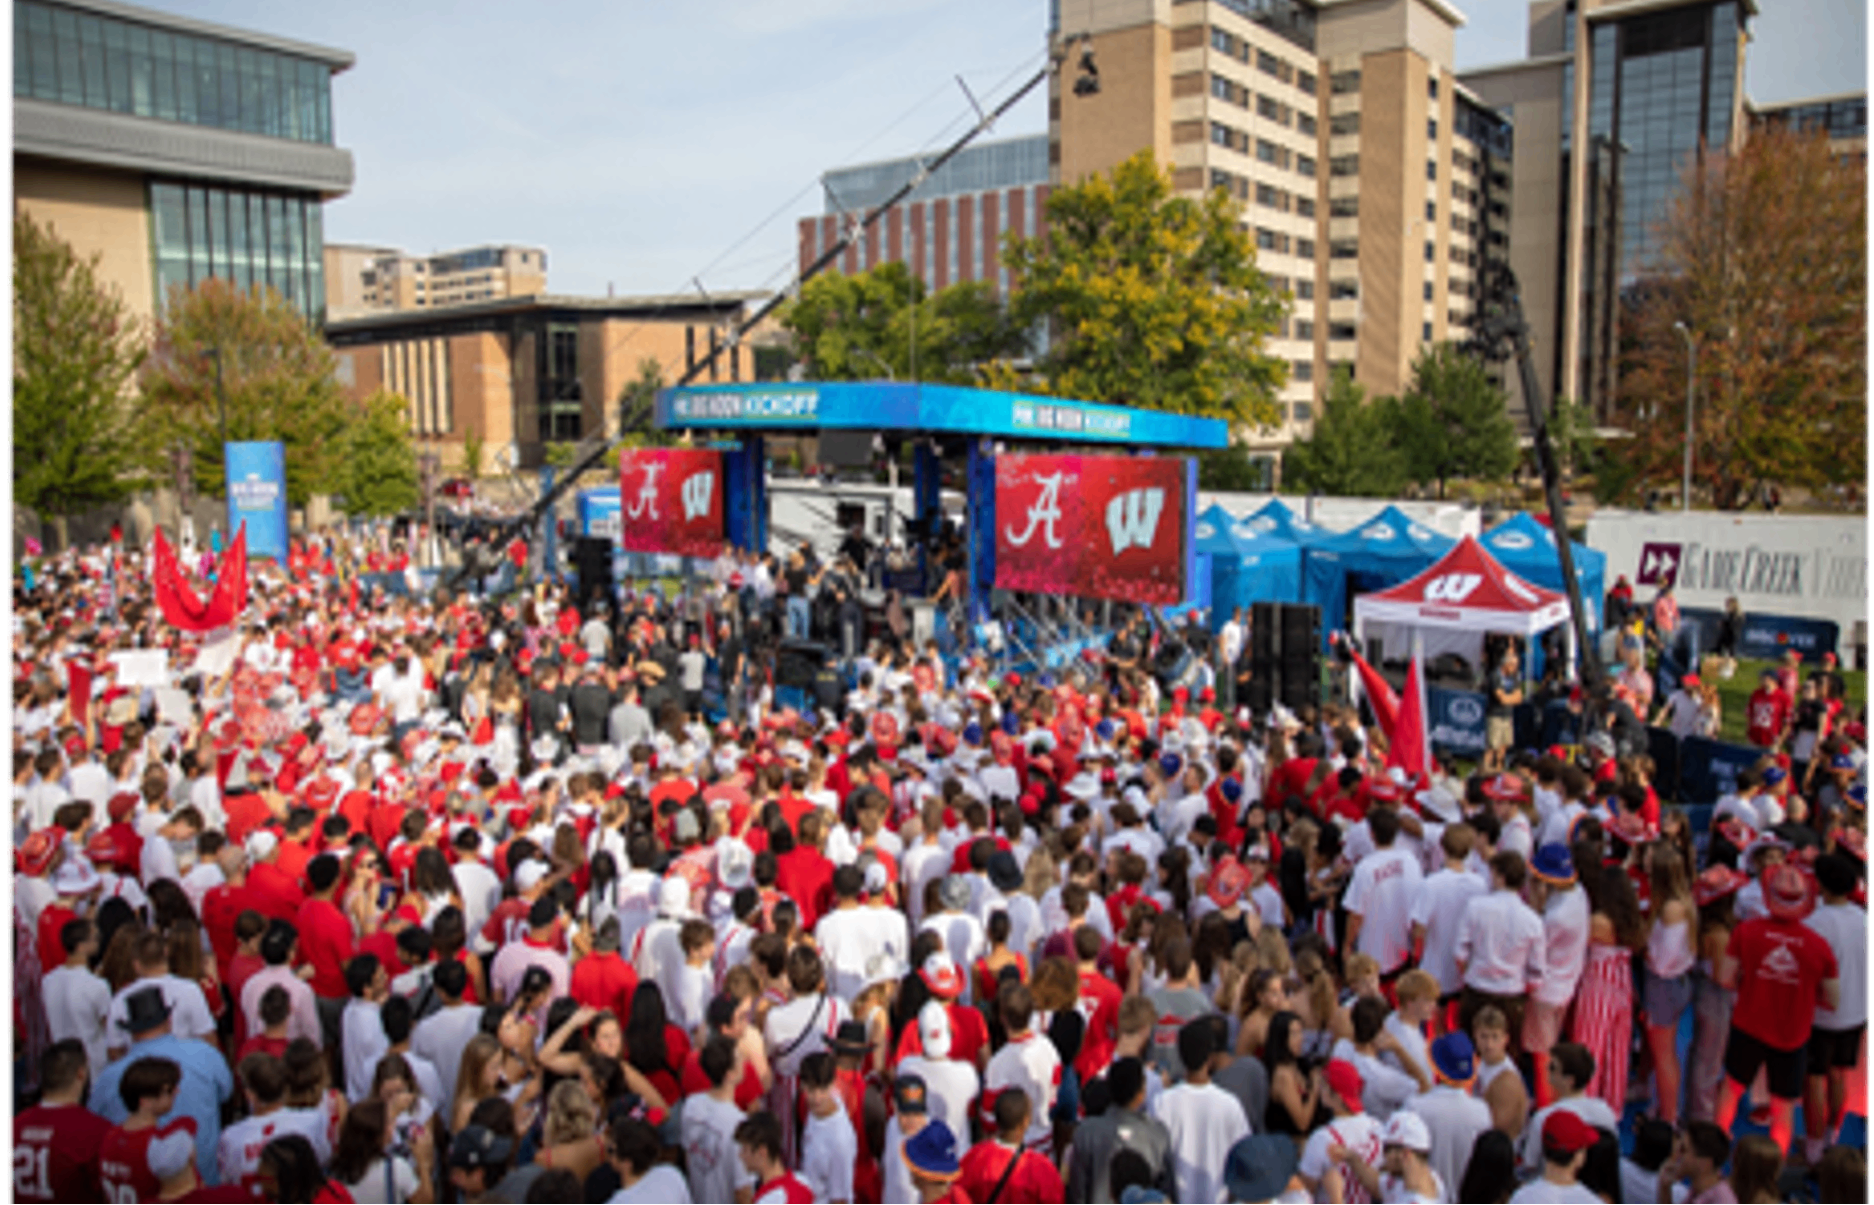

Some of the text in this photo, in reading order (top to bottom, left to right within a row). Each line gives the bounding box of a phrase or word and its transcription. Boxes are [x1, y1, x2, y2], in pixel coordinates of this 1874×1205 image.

[745, 393, 820, 416] KICKOFF
[1004, 469, 1063, 549] A
[1104, 487, 1165, 557] W
